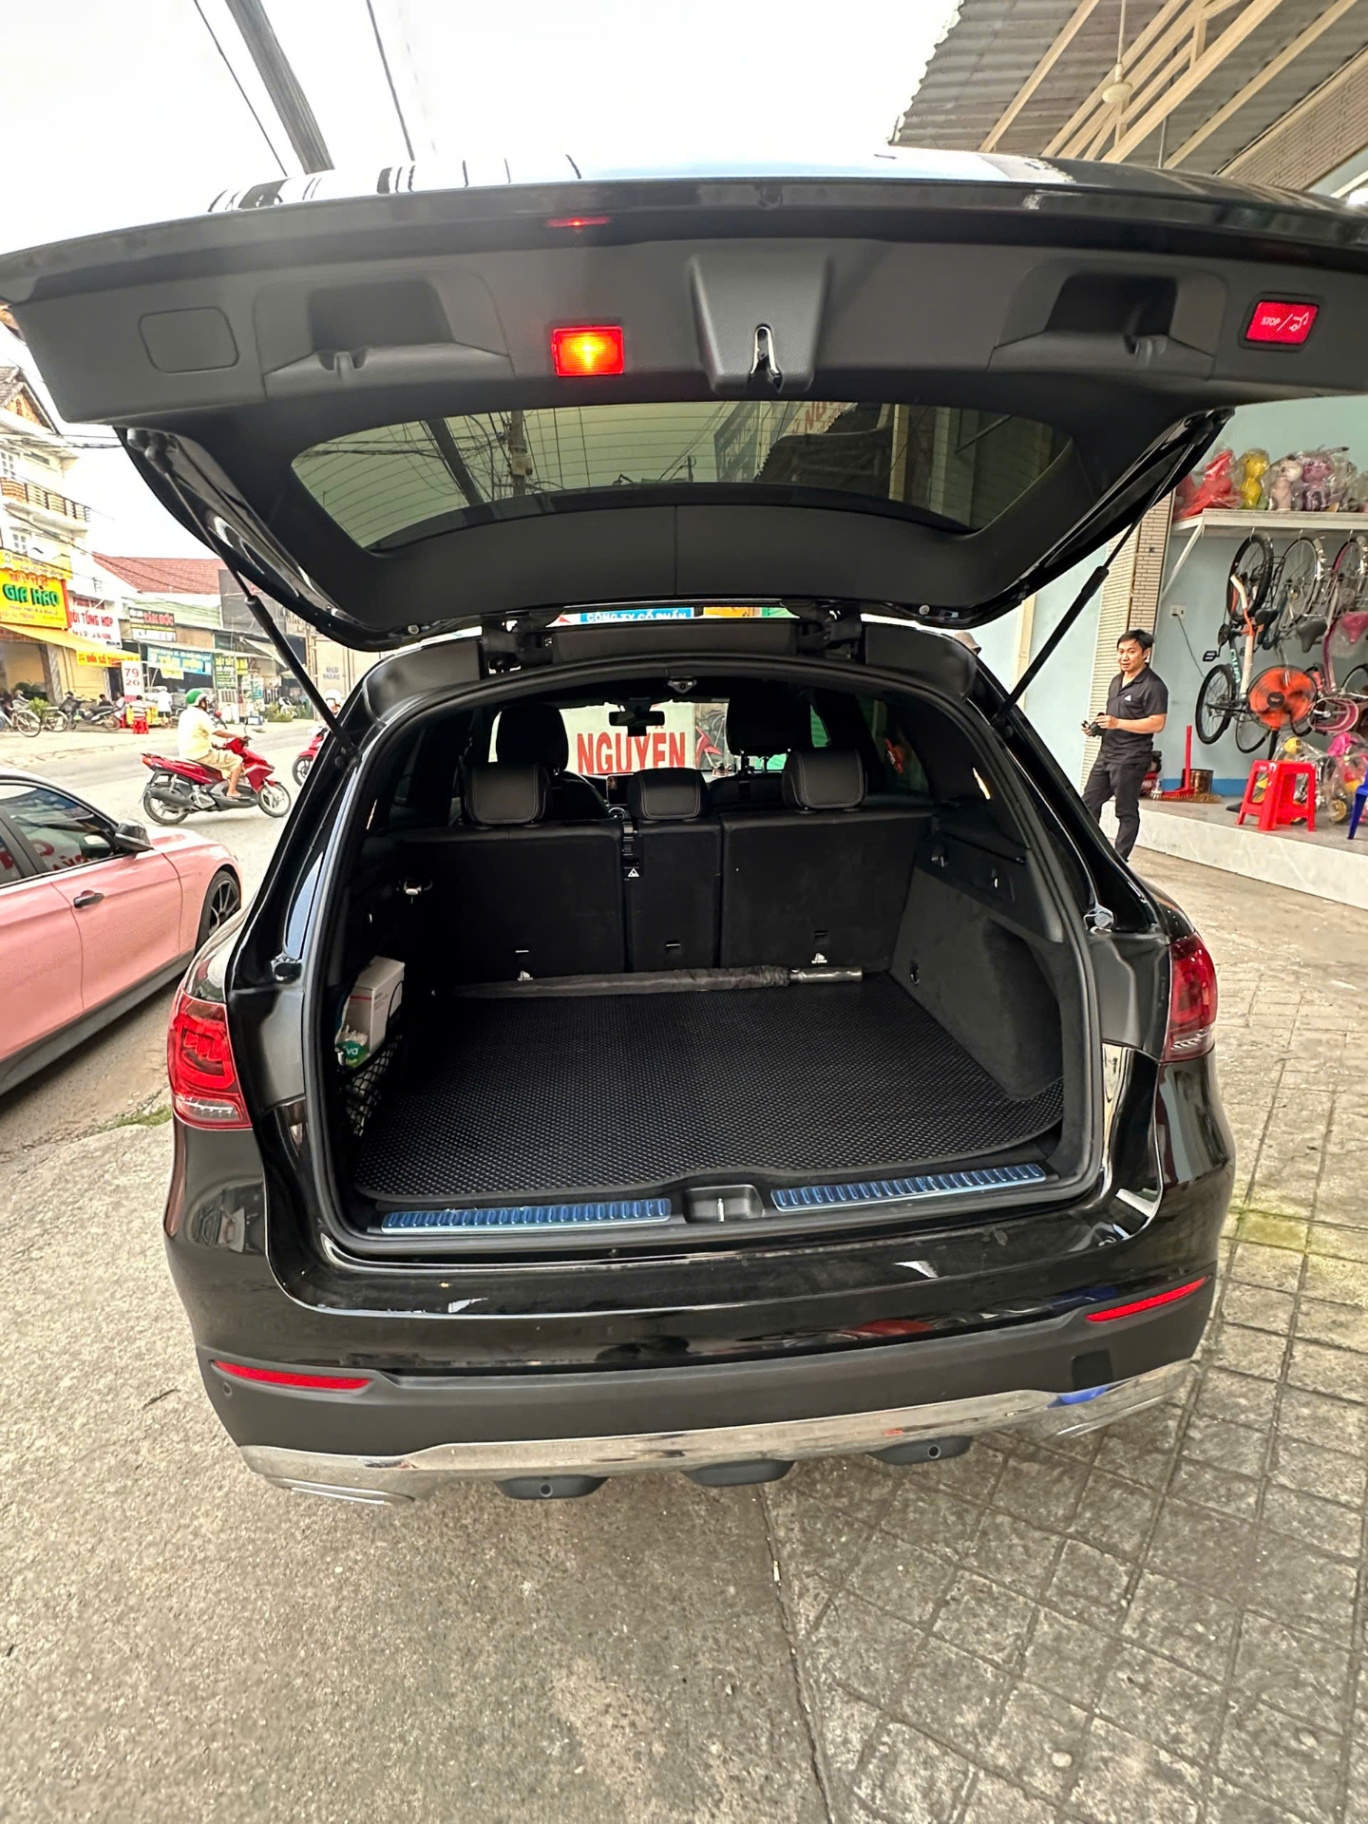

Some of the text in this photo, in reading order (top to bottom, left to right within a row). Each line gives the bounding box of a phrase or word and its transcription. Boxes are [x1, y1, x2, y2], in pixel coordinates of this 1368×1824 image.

[1261, 316, 1281, 326] STOP
[2, 584, 28, 603] GIA
[124, 668, 139, 678] 79
